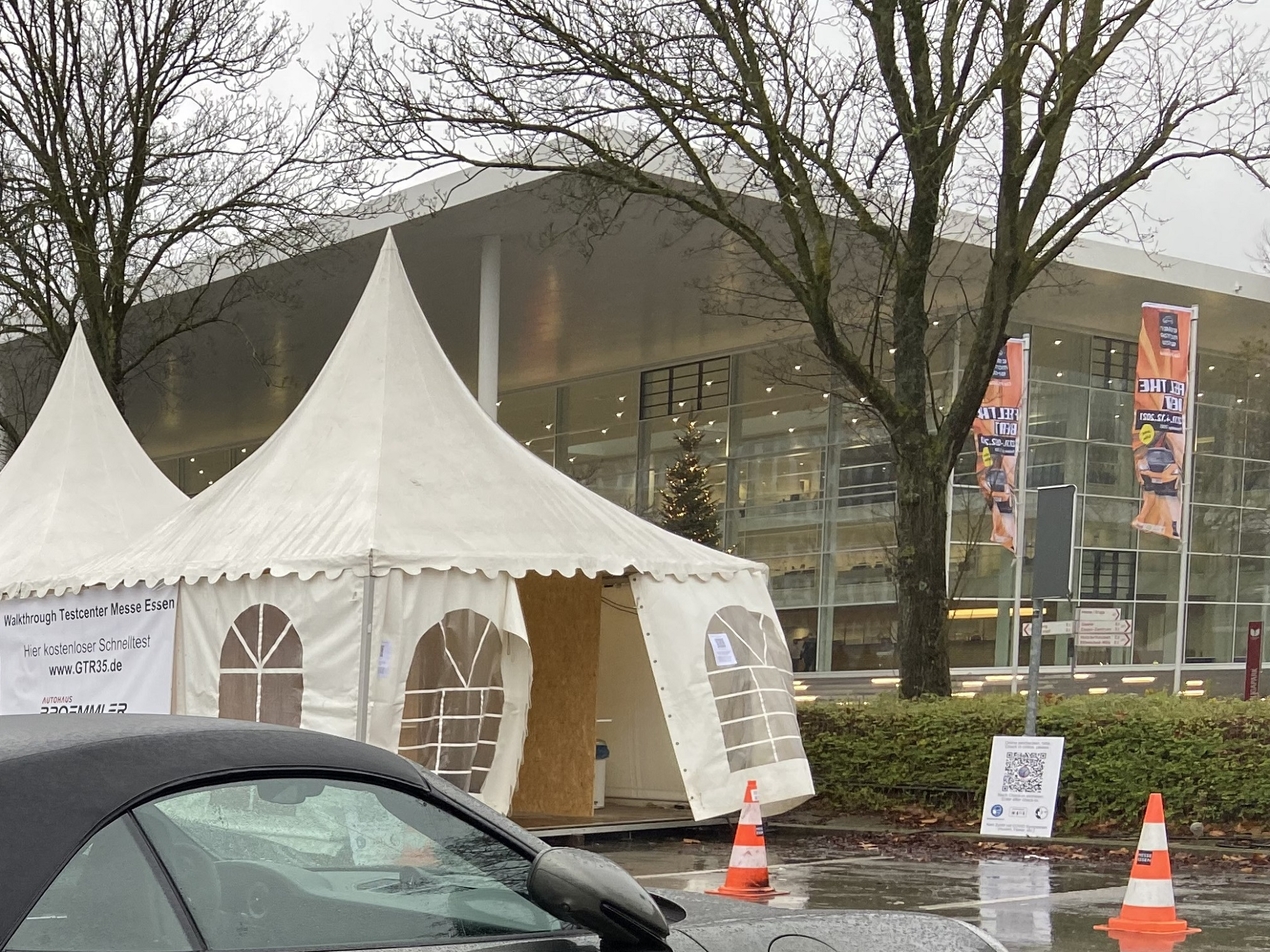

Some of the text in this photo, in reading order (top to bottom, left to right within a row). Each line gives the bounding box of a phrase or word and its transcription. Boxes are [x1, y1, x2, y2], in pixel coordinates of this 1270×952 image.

[3, 598, 175, 627] Walkthrough Testcenter Messe Essen
[23, 634, 151, 658] Hier kostenloser Schnelltest
[48, 659, 123, 676] www.GTR35.de
[41, 696, 73, 704] AUTOHAUS
